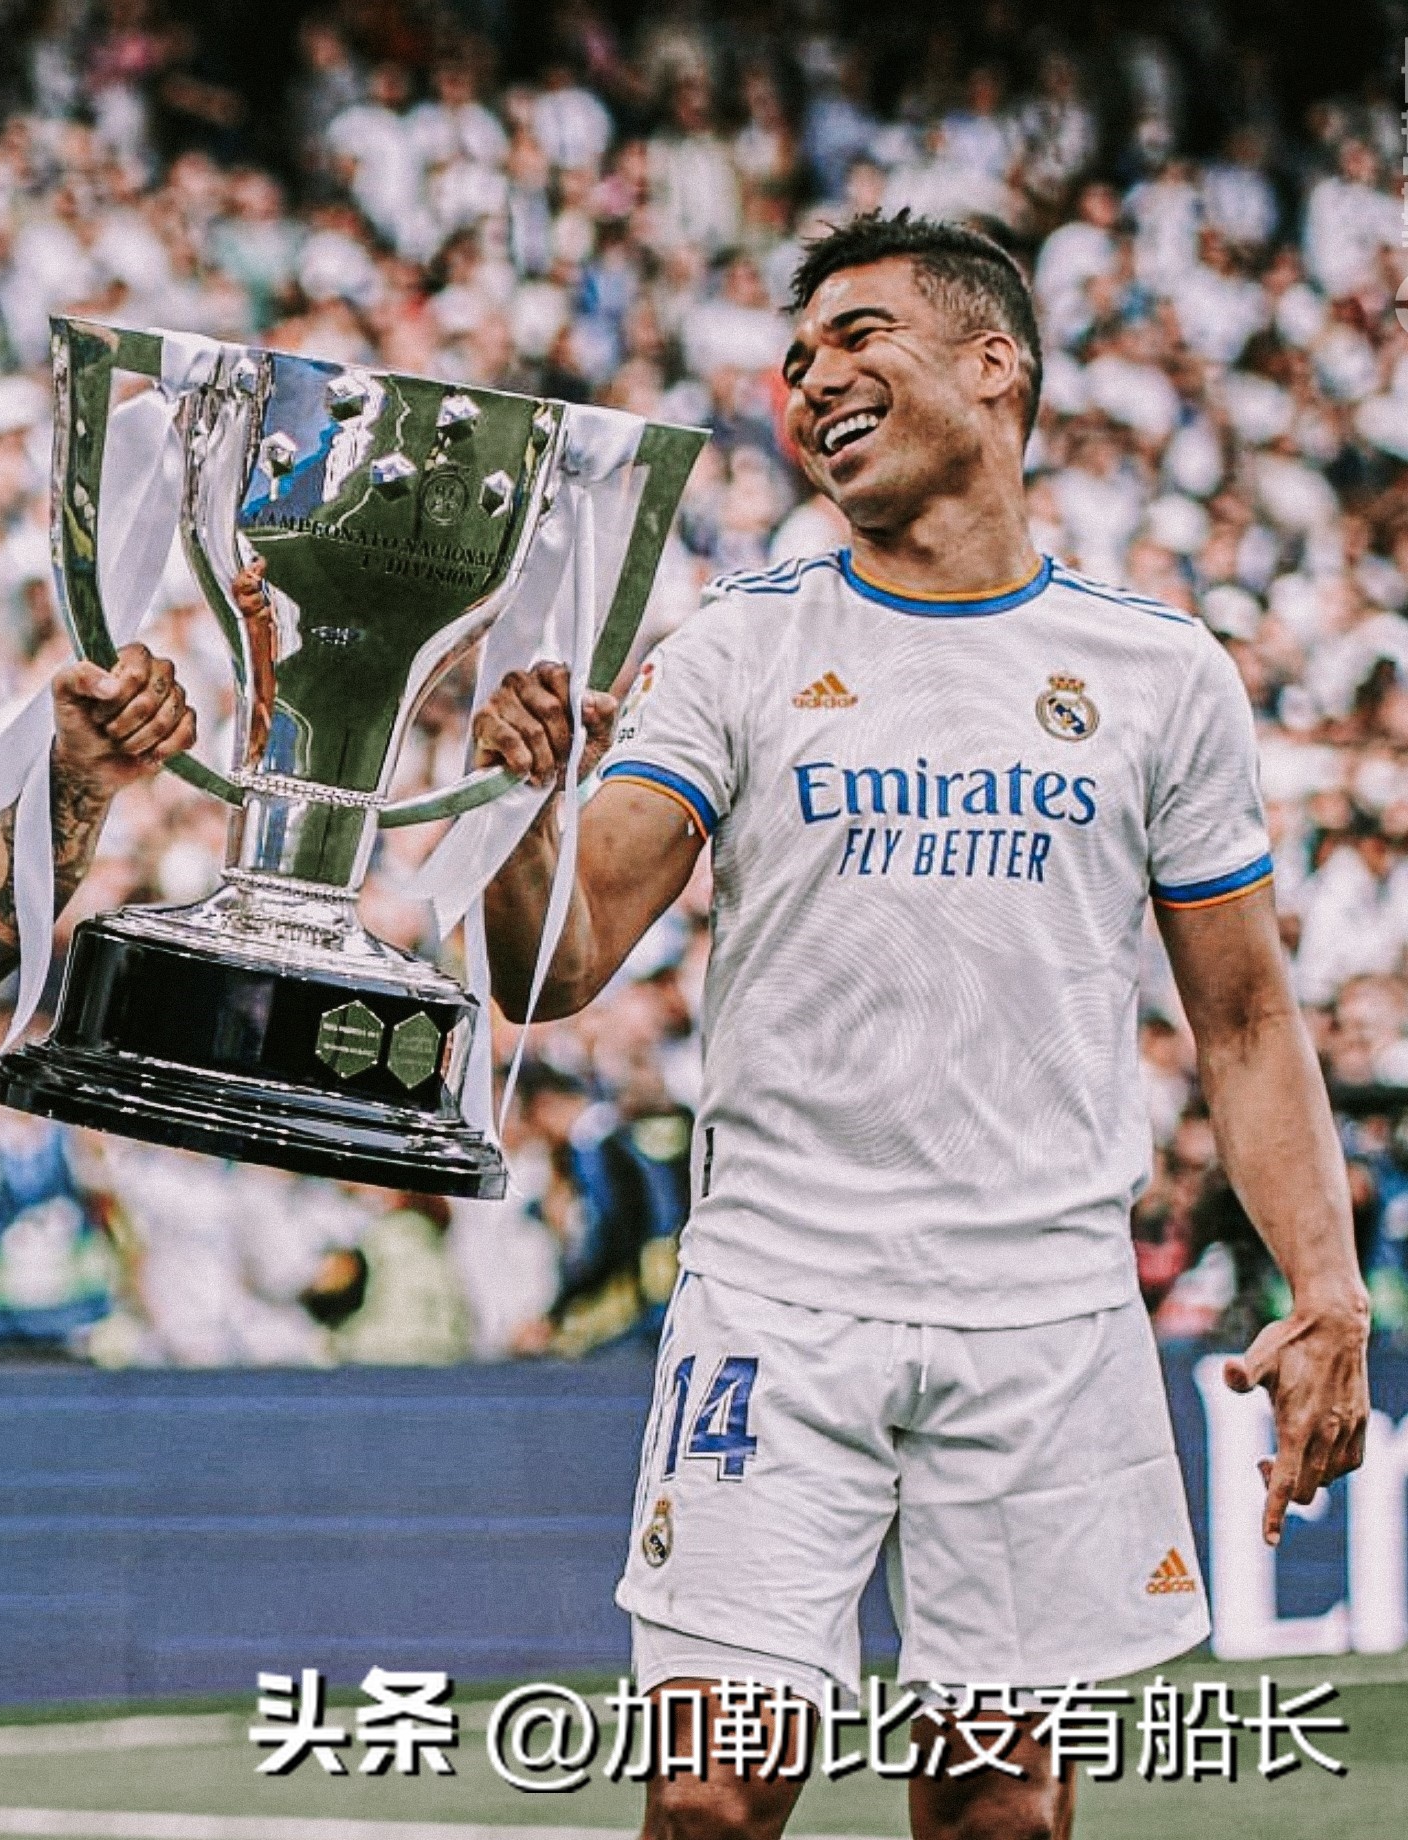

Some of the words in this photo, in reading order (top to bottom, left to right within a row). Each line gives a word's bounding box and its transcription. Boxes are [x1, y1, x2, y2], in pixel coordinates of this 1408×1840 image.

[792, 757, 1097, 825] Emirates
[837, 827, 903, 876] FLY
[913, 829, 1052, 883] BETTER
[661, 1354, 760, 1481] 14
